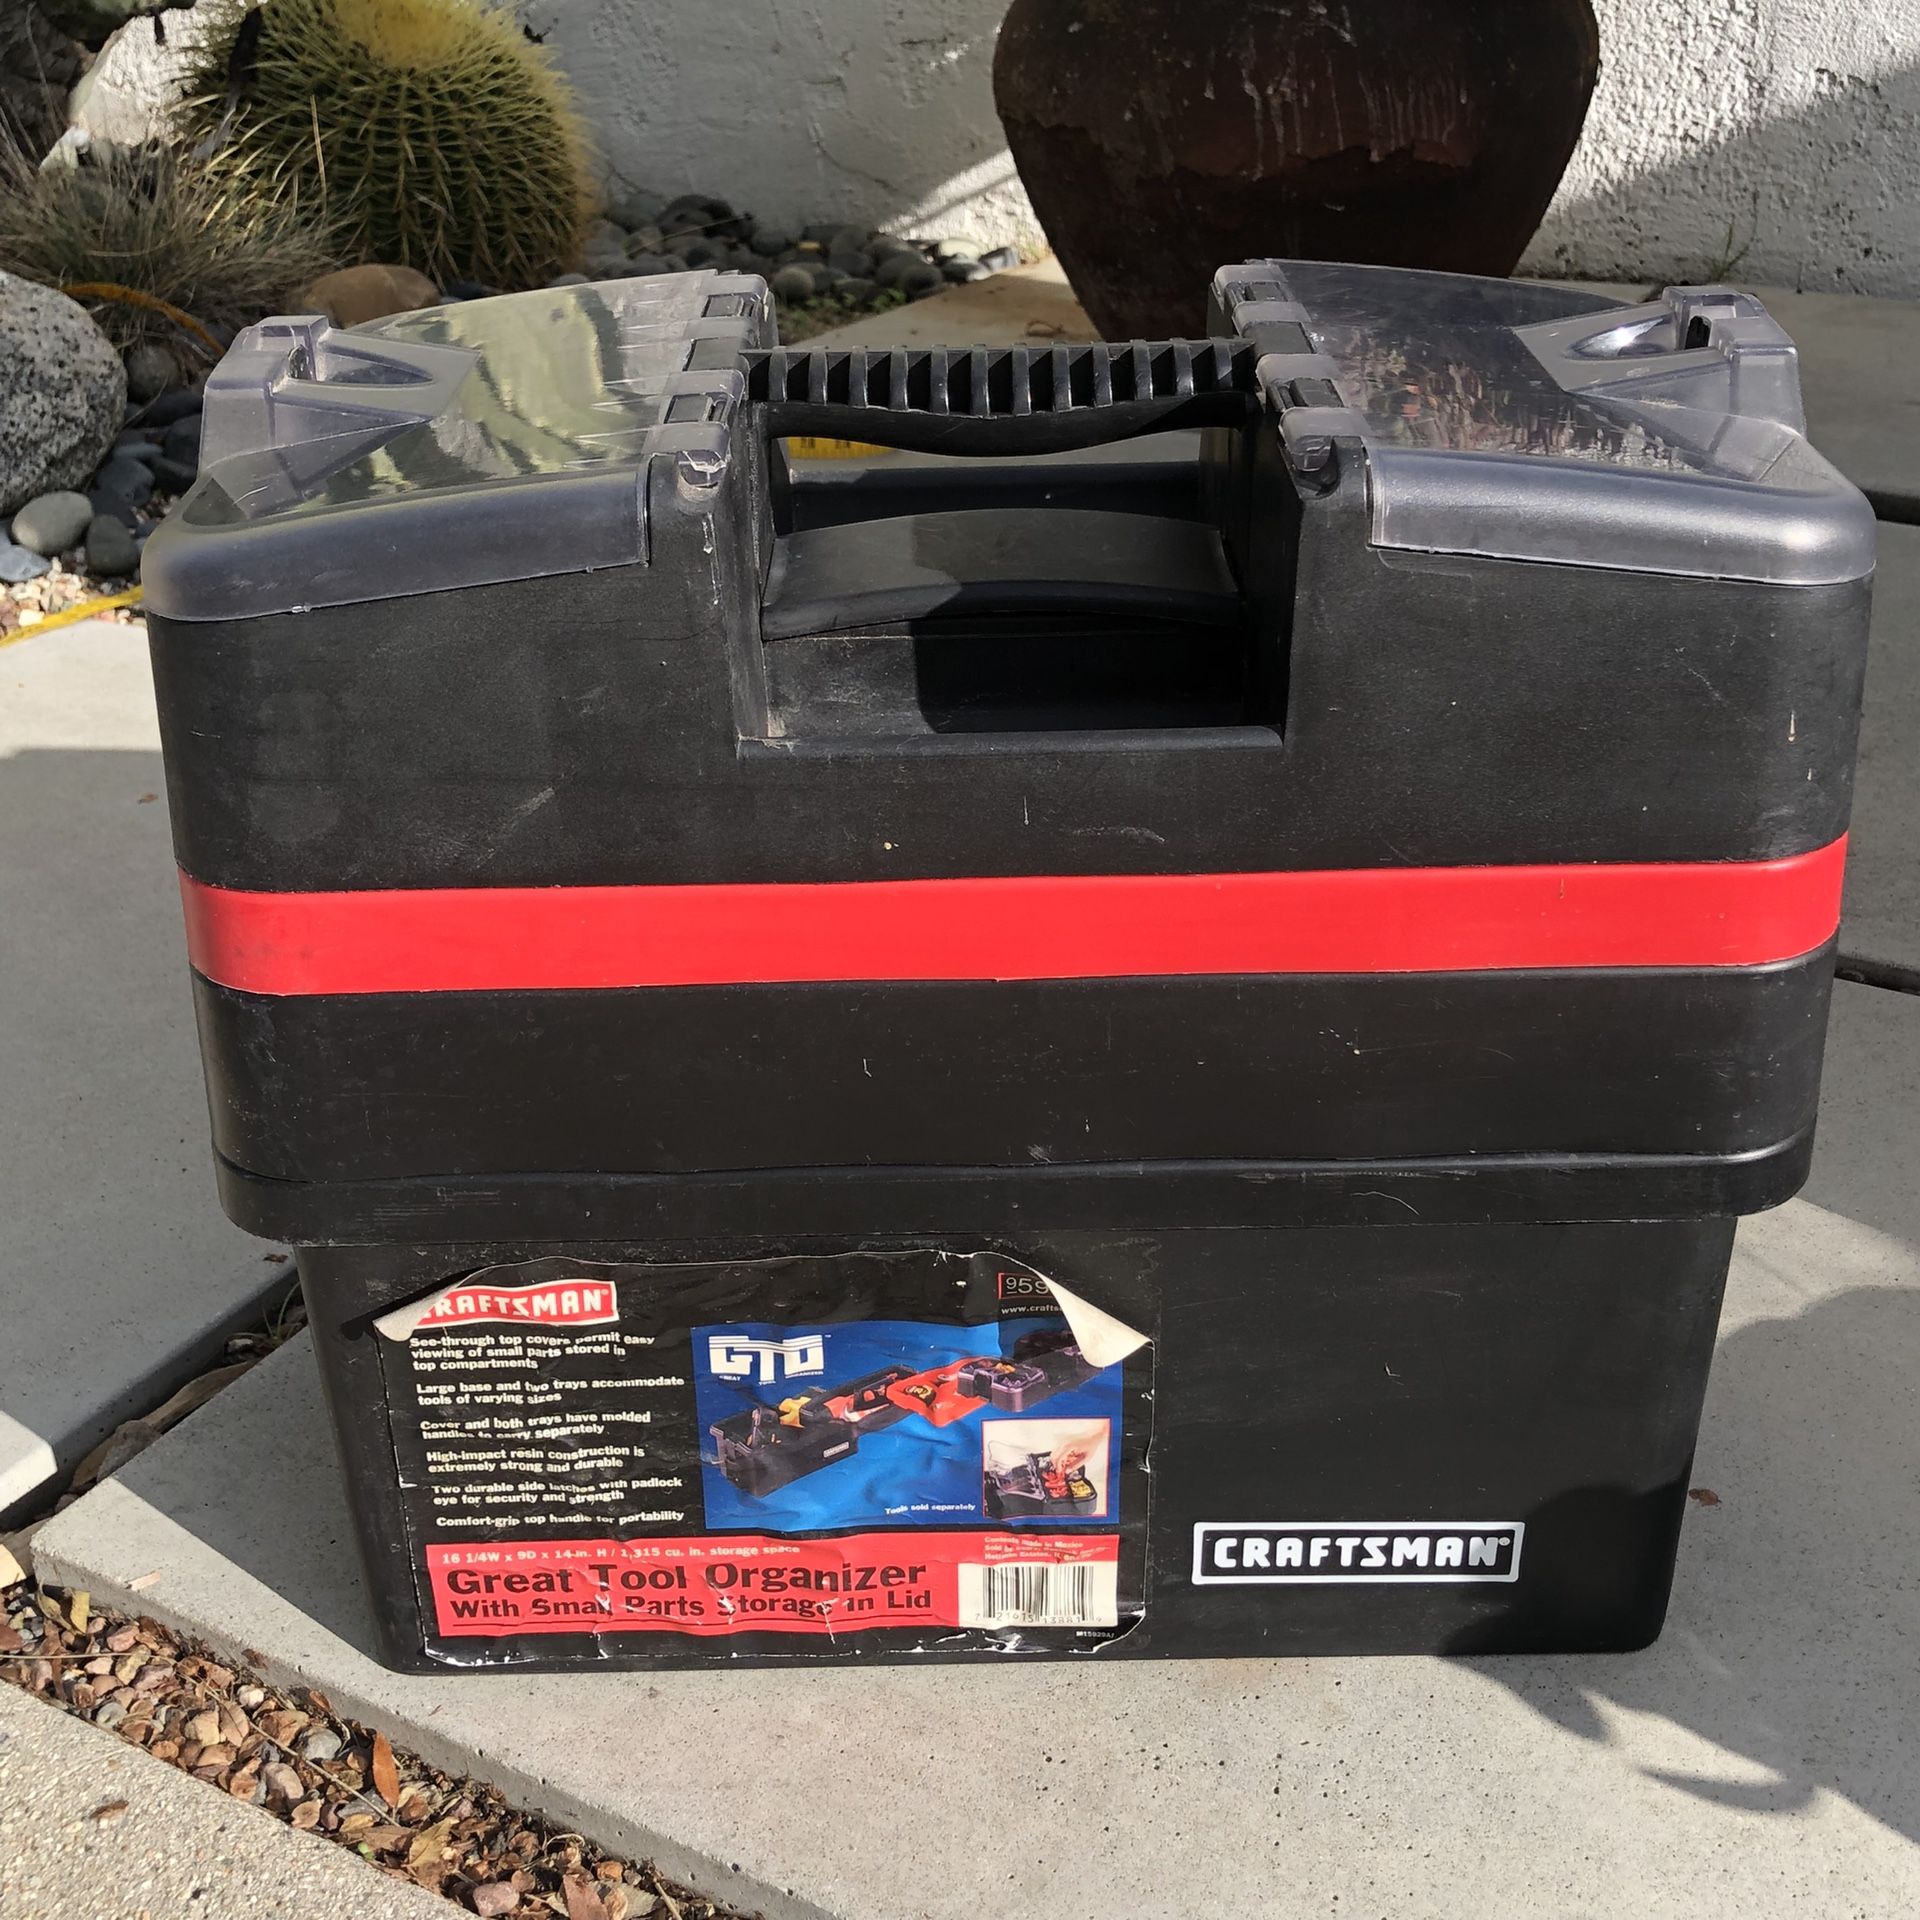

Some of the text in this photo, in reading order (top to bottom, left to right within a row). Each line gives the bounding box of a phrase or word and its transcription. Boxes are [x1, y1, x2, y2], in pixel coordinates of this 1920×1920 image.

[1001, 1304, 1061, 1315] www.crafts
[409, 1332, 655, 1347] See-through top covers permit easy
[411, 1344, 626, 1359] viewing of small parts stored in
[708, 1335, 824, 1381] GTO
[412, 1358, 539, 1372] top compartments
[416, 1376, 684, 1394] Large base and two trays accommodate
[418, 1392, 562, 1406] tools of varying sizes
[420, 1411, 651, 1431] Cover and both trays have molded
[422, 1429, 474, 1440] handles
[535, 1422, 604, 1440] separately
[427, 1445, 645, 1462] High-impact resin construction is
[428, 1457, 623, 1474] extremely strong and durable
[431, 1484, 460, 1494] Two
[464, 1482, 514, 1493] durable
[518, 1481, 545, 1492] side
[599, 1478, 628, 1490] with
[632, 1477, 683, 1490] padlock
[433, 1490, 625, 1506] eye for security and strength
[884, 1503, 976, 1515] Tools sold separately
[436, 1509, 685, 1528] Comfort-grip top handle for portability
[442, 1552, 460, 1564] 16
[466, 1551, 500, 1563] 1/4W
[504, 1553, 513, 1562] x
[517, 1550, 536, 1560] 9D
[542, 1551, 549, 1559] x
[596, 1548, 607, 1557] H
[665, 1547, 684, 1557] cu.
[689, 1546, 704, 1557] in.
[710, 1546, 759, 1558] storage
[763, 1545, 801, 1555] space
[447, 1562, 926, 1594] Great Tool Organizer
[450, 1599, 519, 1618] With
[625, 1595, 704, 1616] Parts
[717, 1595, 832, 1618] Storage
[887, 1590, 931, 1609] Lid
